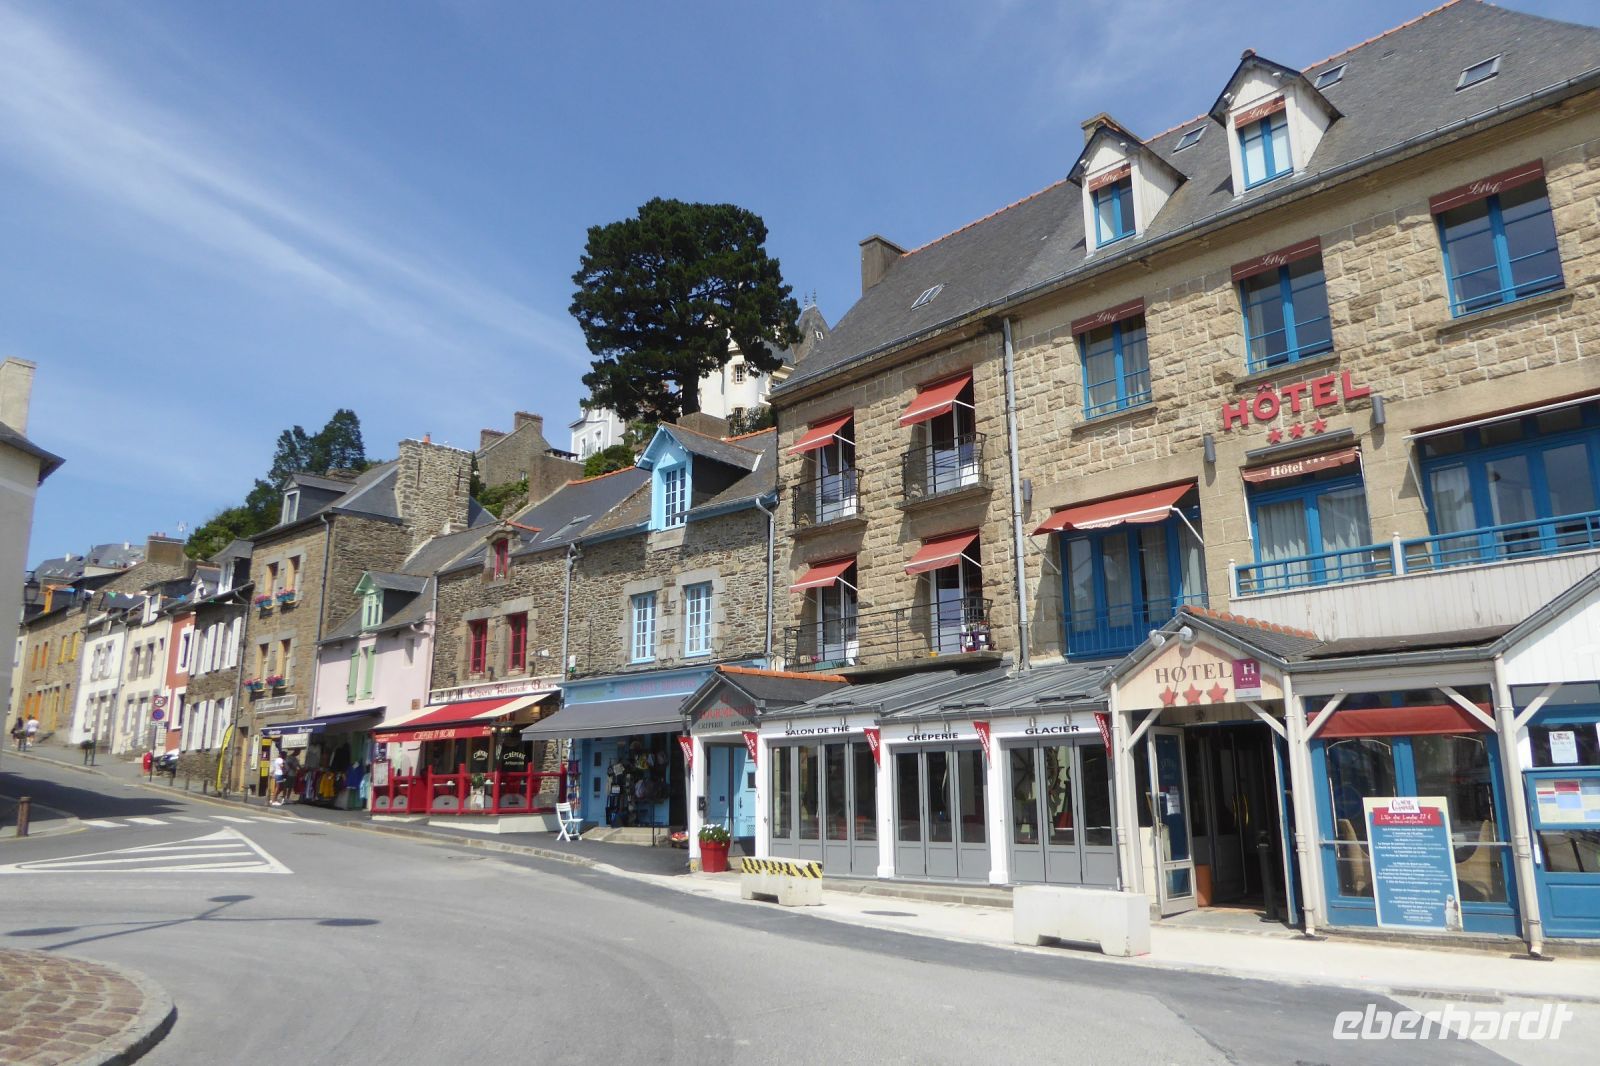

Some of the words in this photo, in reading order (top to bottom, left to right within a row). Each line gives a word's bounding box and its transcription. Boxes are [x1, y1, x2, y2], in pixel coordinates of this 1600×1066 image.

[1222, 369, 1370, 430] HÔTEL
[1270, 462, 1303, 477] Hôtel
[907, 732, 958, 741] CRÊPERIE
[1025, 726, 1080, 735] GLACIER
